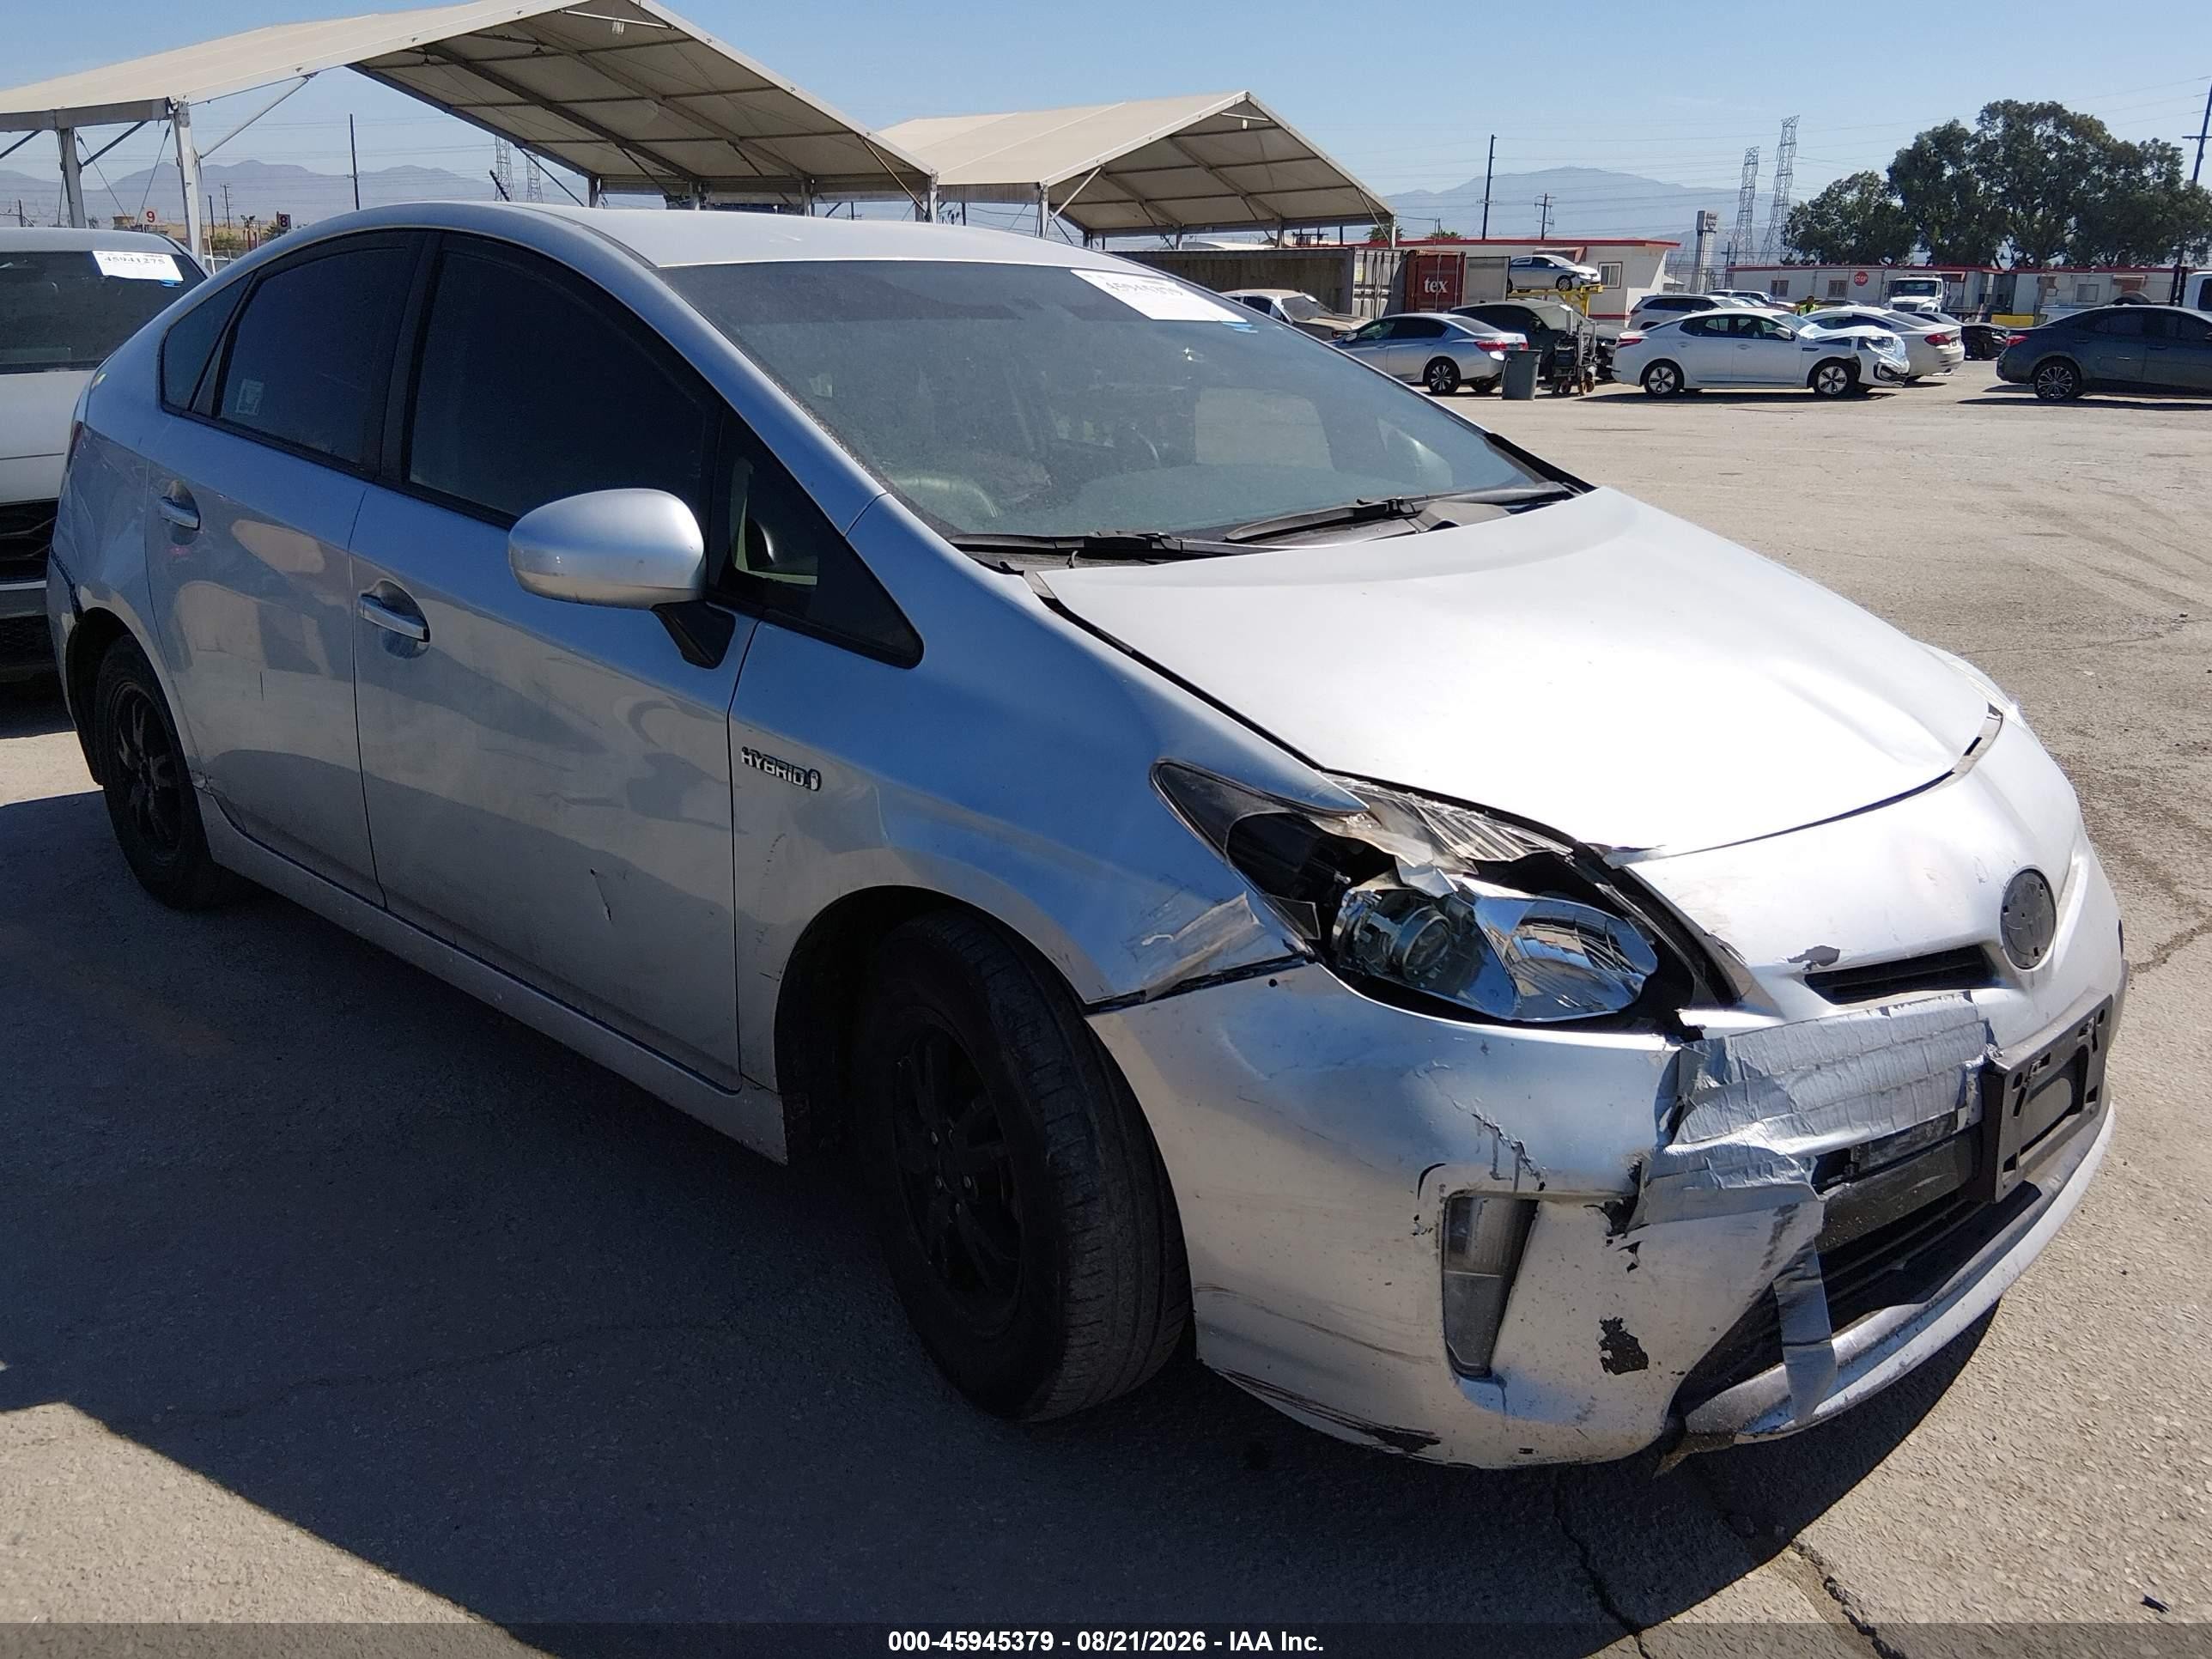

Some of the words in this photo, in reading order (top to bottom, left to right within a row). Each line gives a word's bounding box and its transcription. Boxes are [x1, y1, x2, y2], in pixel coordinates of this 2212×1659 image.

[146, 210, 155, 223] 9
[280, 216, 288, 228] 8
[1424, 277, 1448, 293] tex
[741, 746, 805, 787] HYBRID
